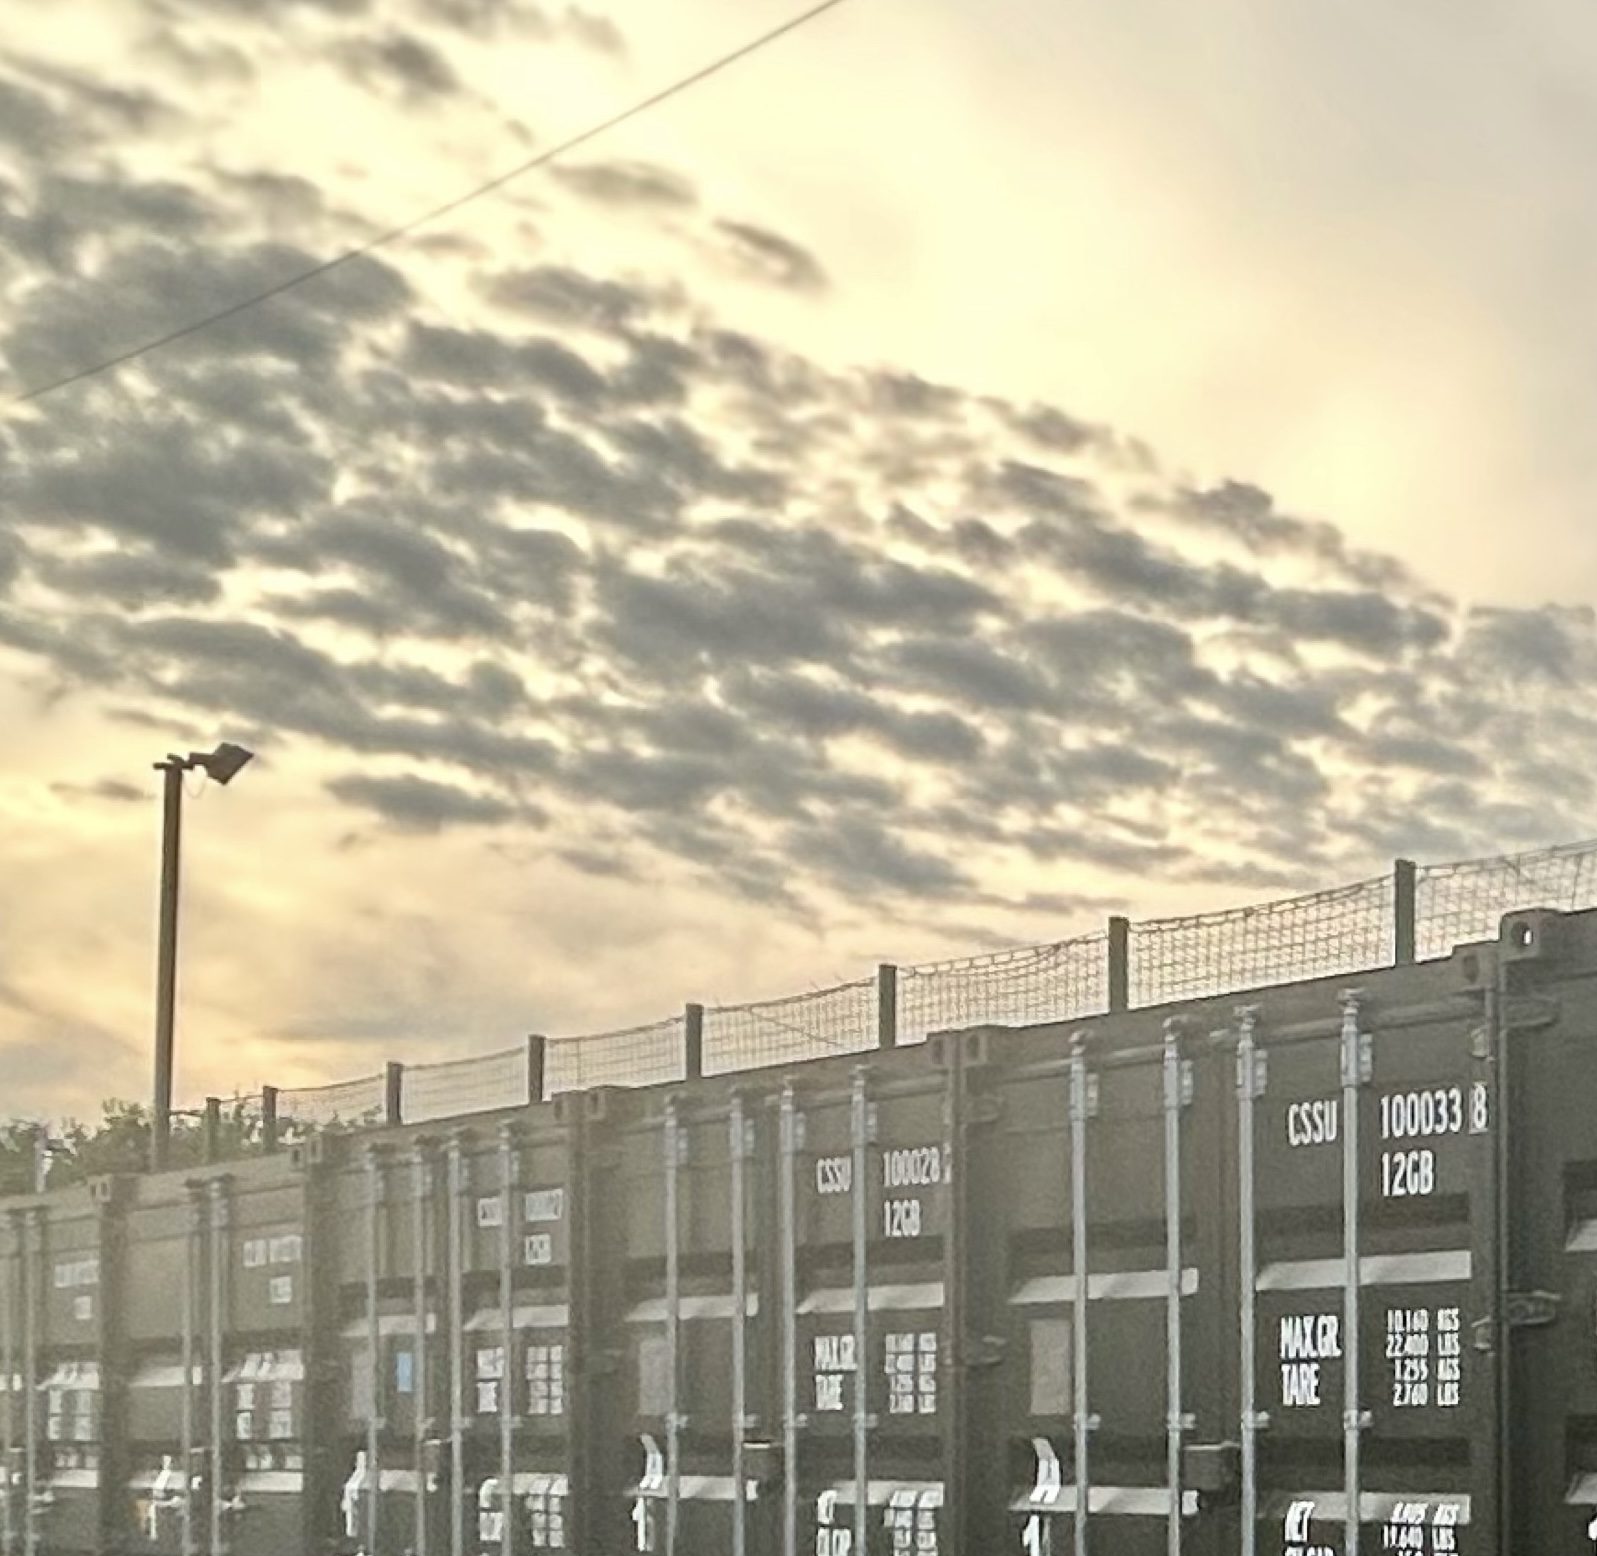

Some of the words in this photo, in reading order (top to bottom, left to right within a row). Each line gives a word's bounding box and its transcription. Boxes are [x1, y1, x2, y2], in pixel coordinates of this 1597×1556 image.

[1288, 1101, 1338, 1146] CSSU
[1381, 1088, 1463, 1139] 100033
[1471, 1082, 1488, 1131] 8
[1381, 1150, 1433, 1197] 12GB
[1281, 1363, 1321, 1407] TARE
